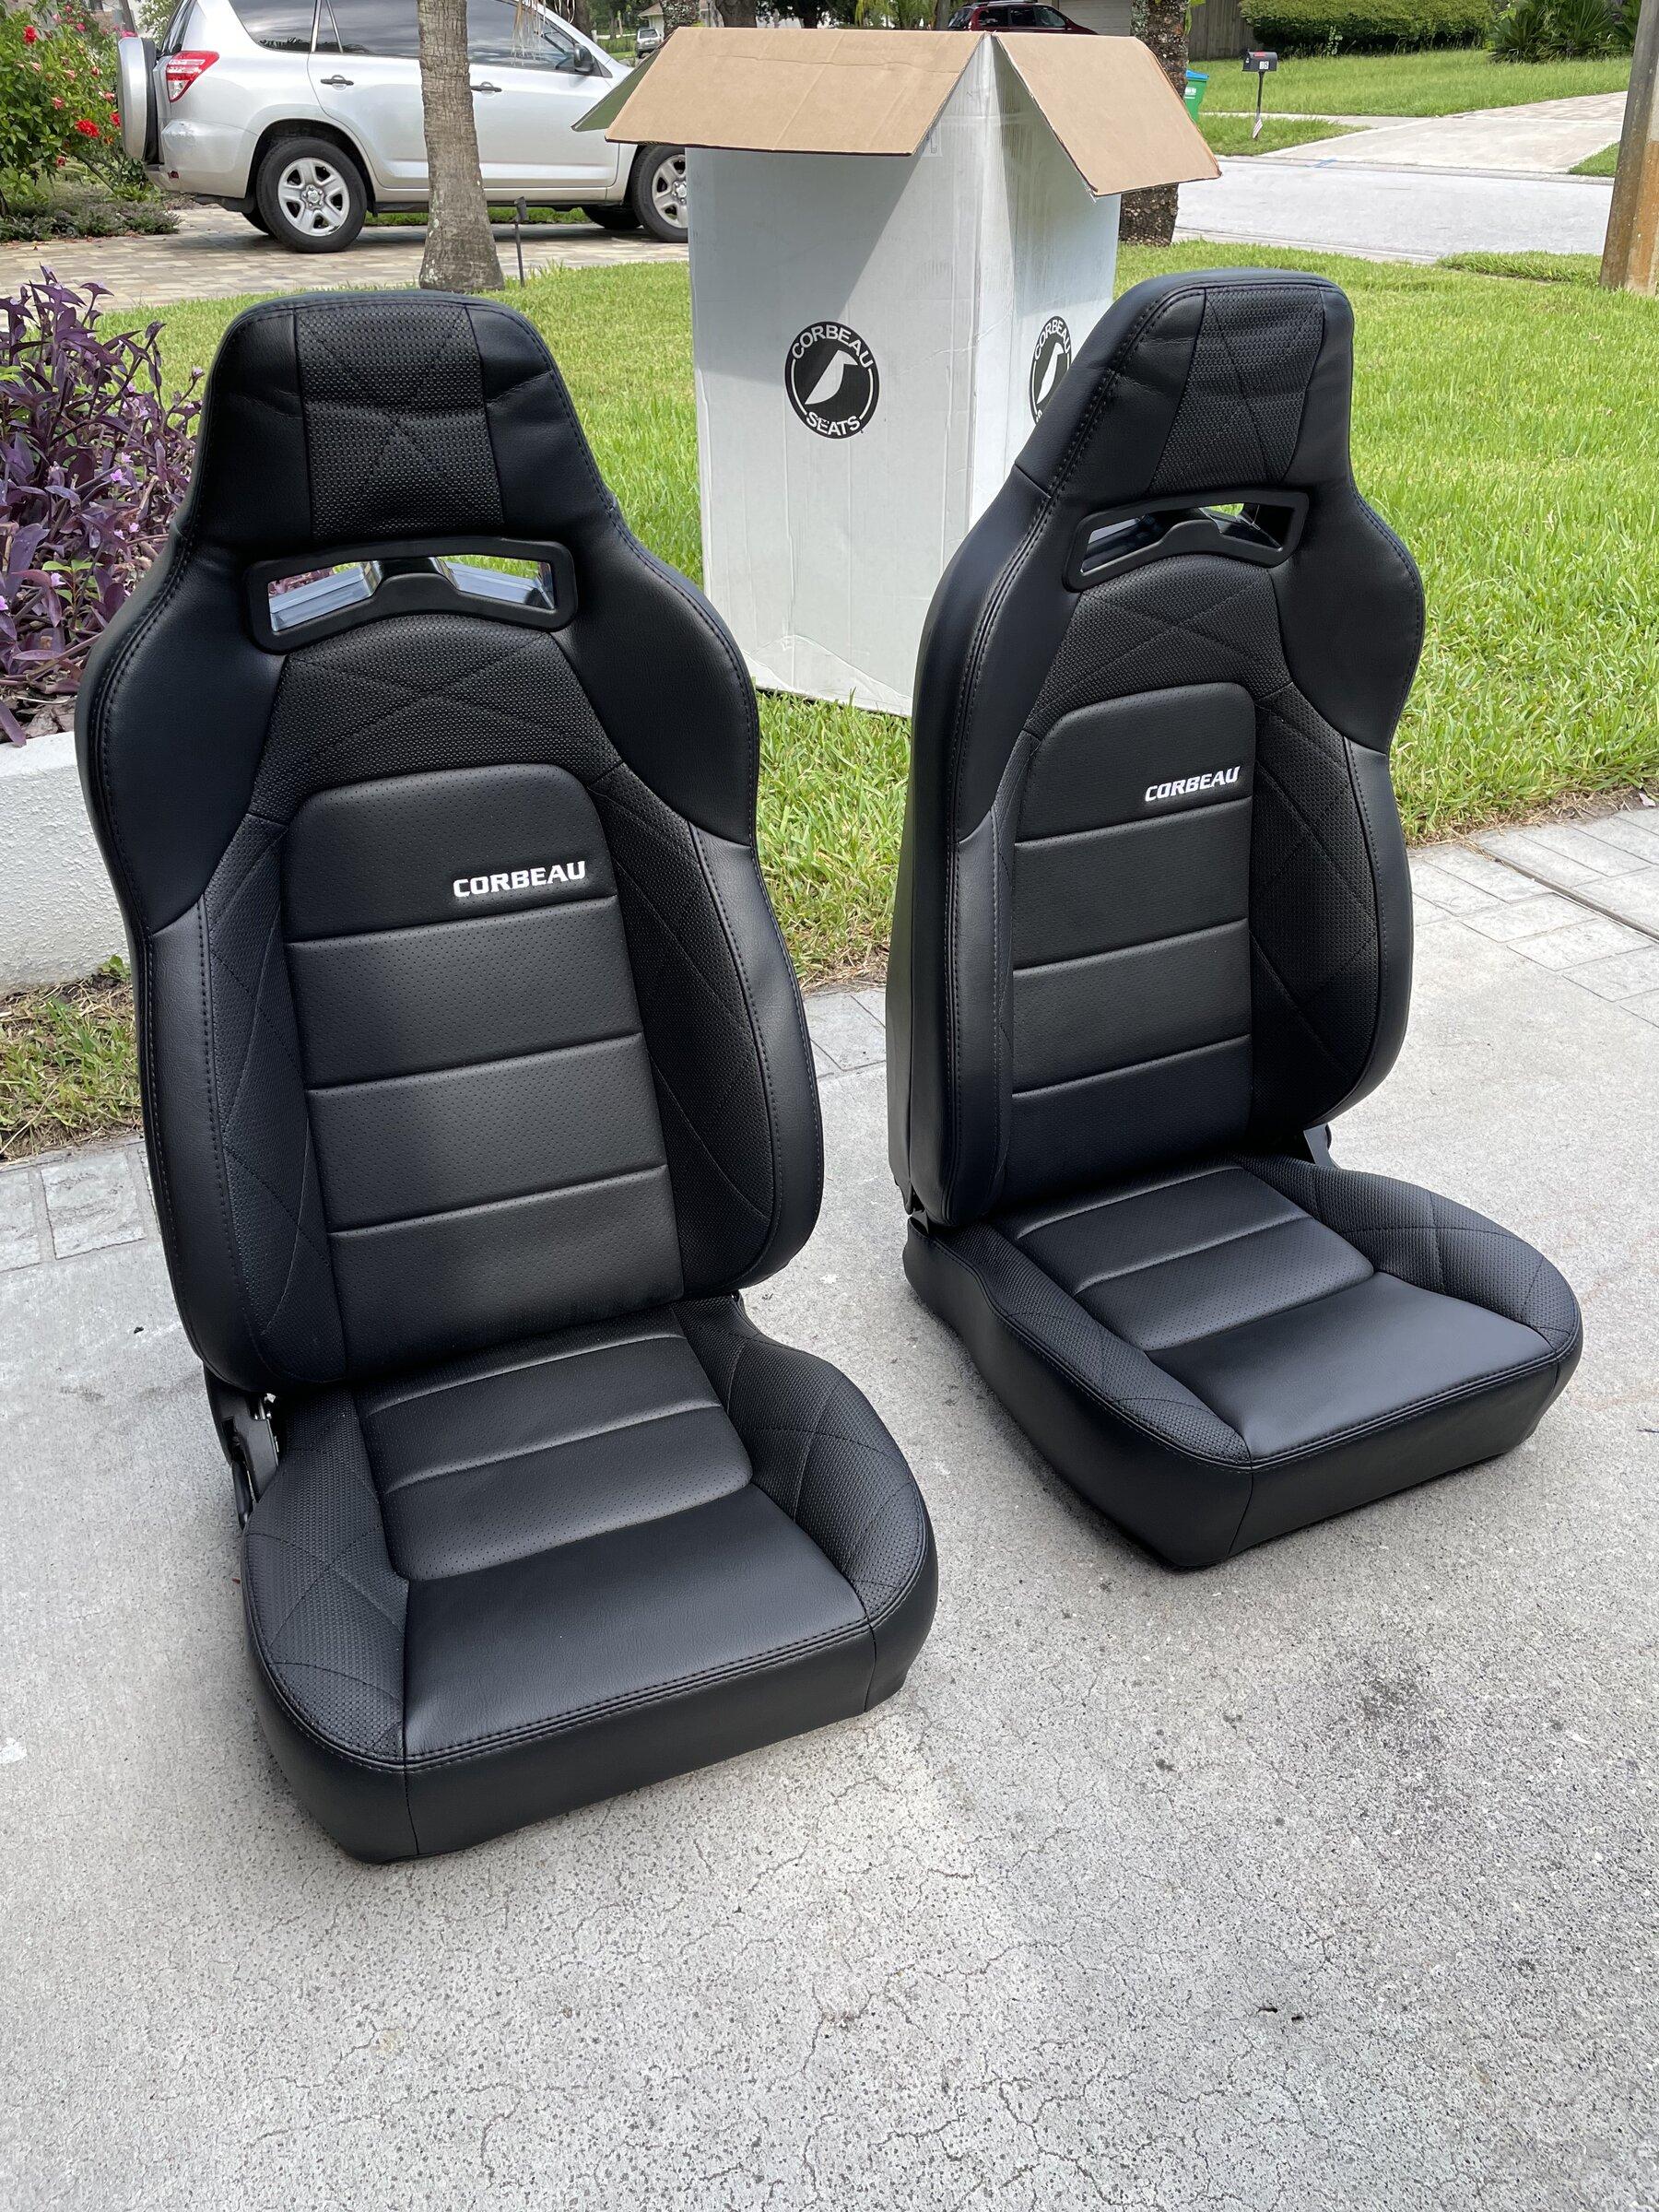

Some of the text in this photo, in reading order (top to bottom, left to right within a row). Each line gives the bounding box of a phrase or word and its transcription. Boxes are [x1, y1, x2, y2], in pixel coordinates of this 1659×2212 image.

[792, 324, 873, 368] CORBEAU
[1034, 319, 1070, 360] CORBEAU
[806, 411, 860, 436] SEATS
[1145, 765, 1241, 802] CORBEAU
[453, 860, 586, 898] CORBEAU
